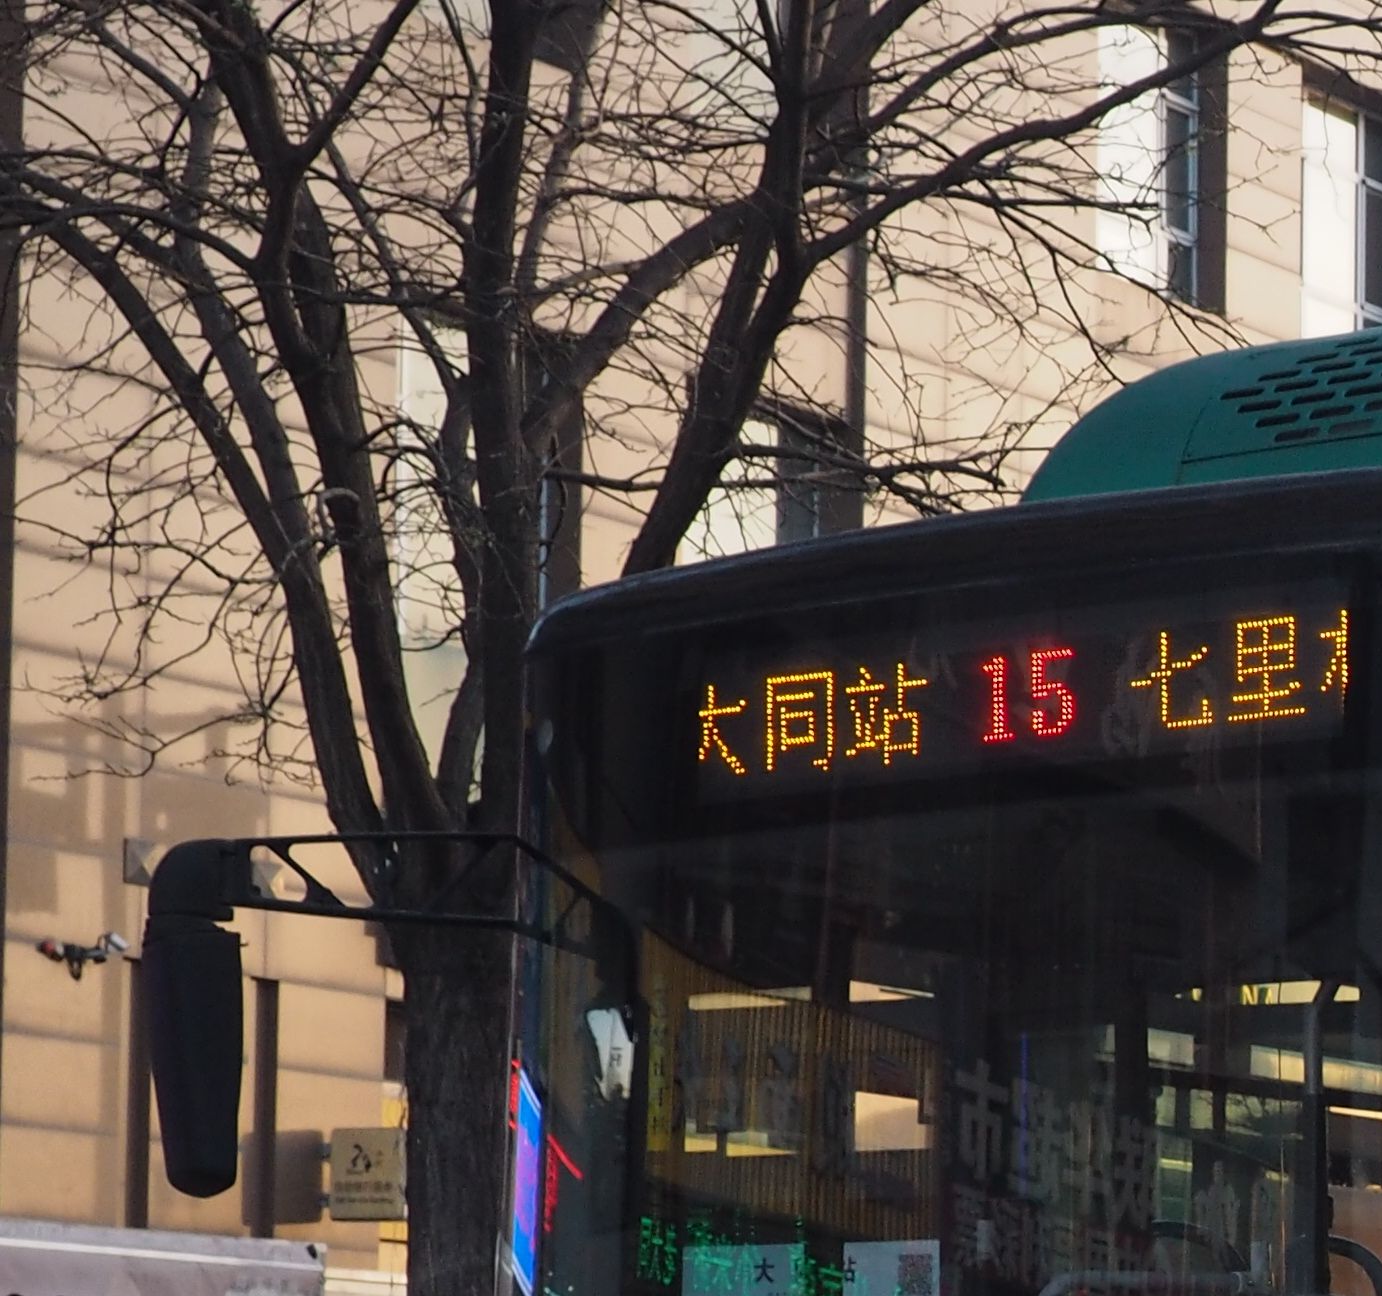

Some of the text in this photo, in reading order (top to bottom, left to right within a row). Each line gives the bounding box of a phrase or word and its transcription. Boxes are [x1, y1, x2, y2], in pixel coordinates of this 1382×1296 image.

[697, 660, 930, 776] 大同站
[980, 648, 1077, 743] 15
